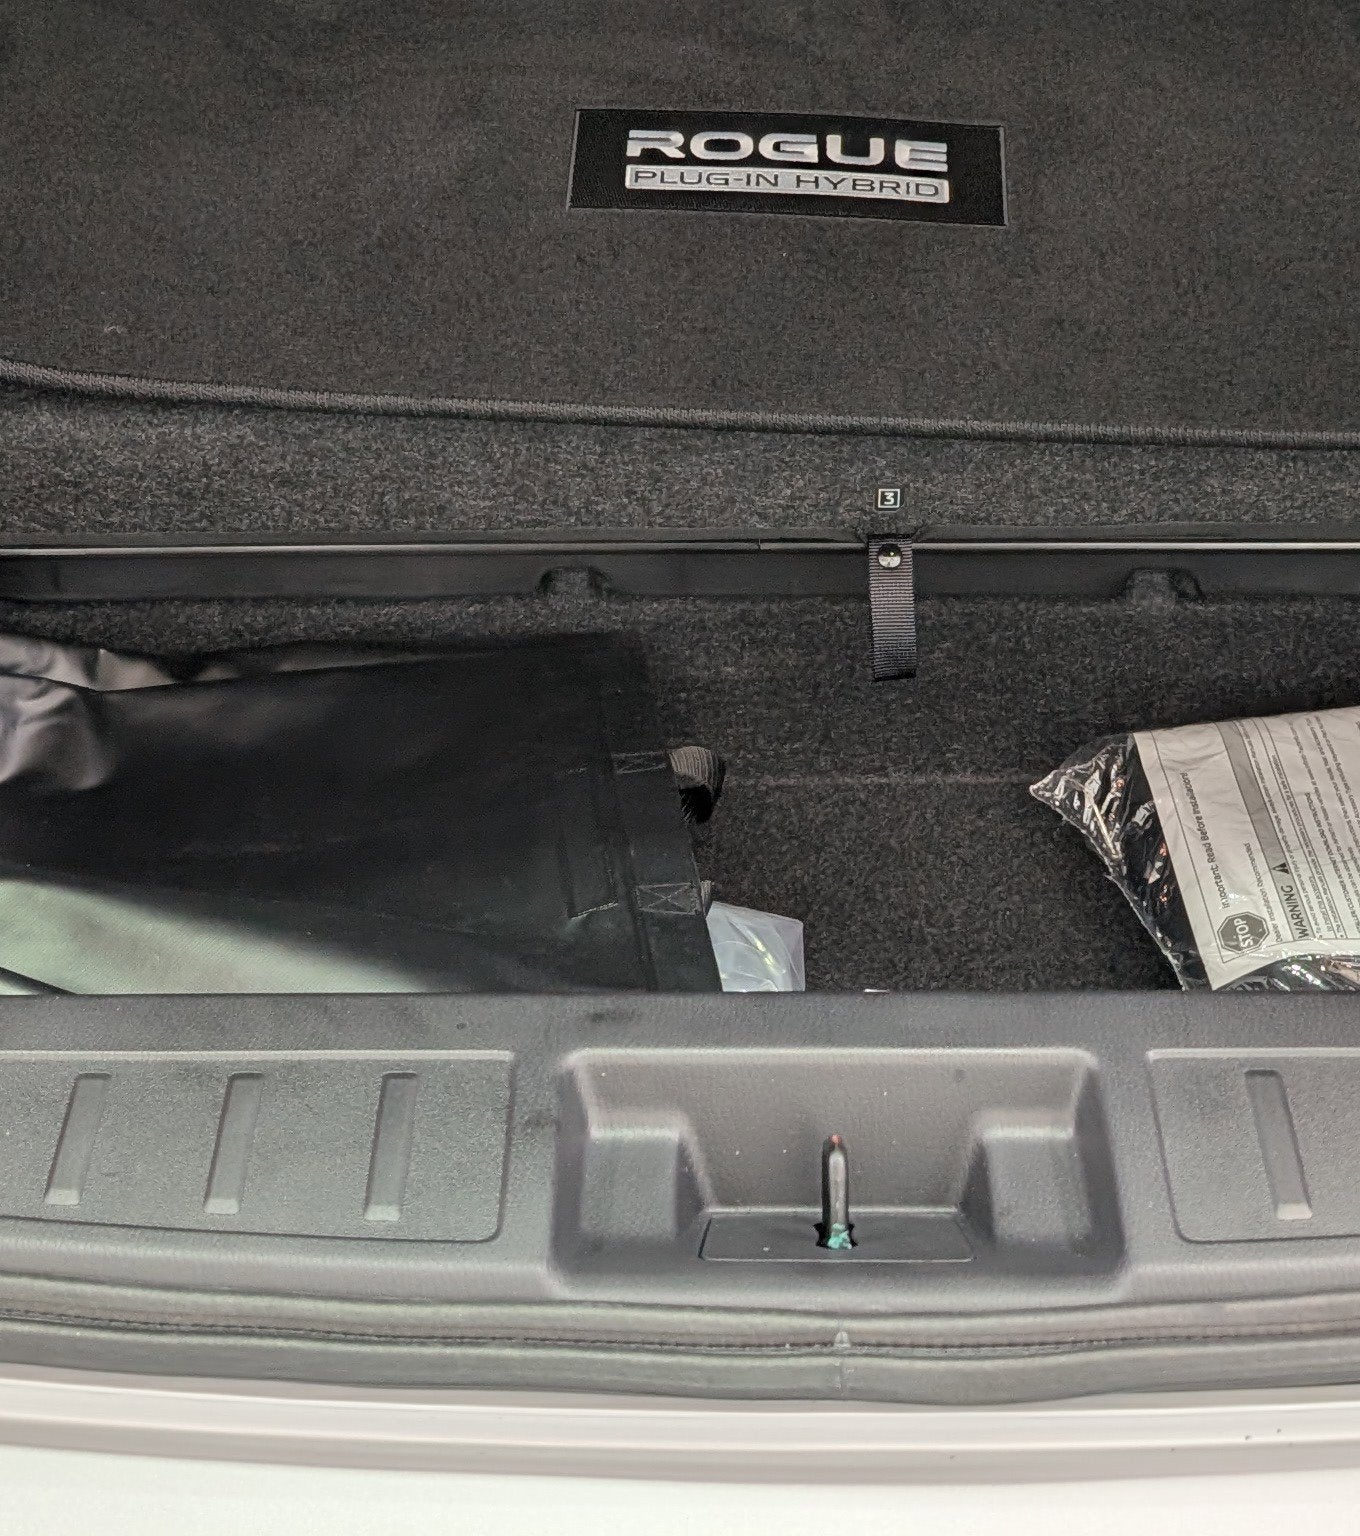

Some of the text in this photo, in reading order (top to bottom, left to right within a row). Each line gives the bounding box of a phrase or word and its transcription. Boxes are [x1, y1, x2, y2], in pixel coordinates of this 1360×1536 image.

[625, 128, 949, 173] ROGUE
[633, 170, 940, 199] PLUG-IN HYBRID
[1195, 815, 1208, 840] Before
[1202, 842, 1215, 862] Read
[1281, 885, 1308, 937] WARNING
[1234, 918, 1254, 947] STOP
